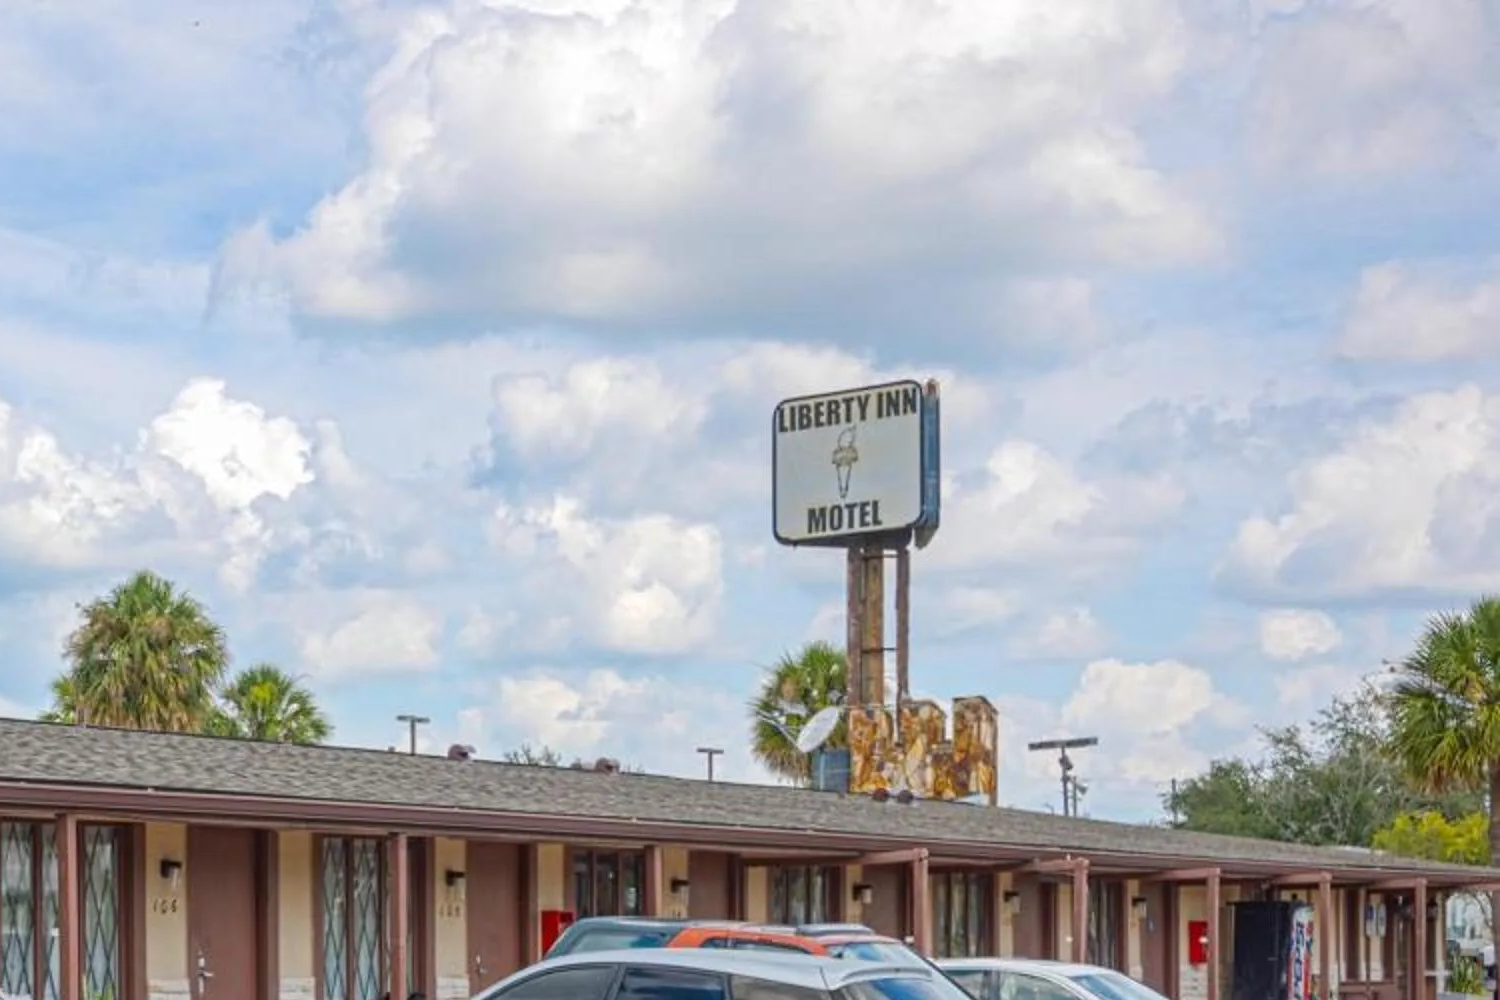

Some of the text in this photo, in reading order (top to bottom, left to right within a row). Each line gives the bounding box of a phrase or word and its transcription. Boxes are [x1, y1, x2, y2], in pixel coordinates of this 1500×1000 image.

[778, 387, 917, 433] LIBERTY INN
[807, 500, 882, 534] MOTEL
